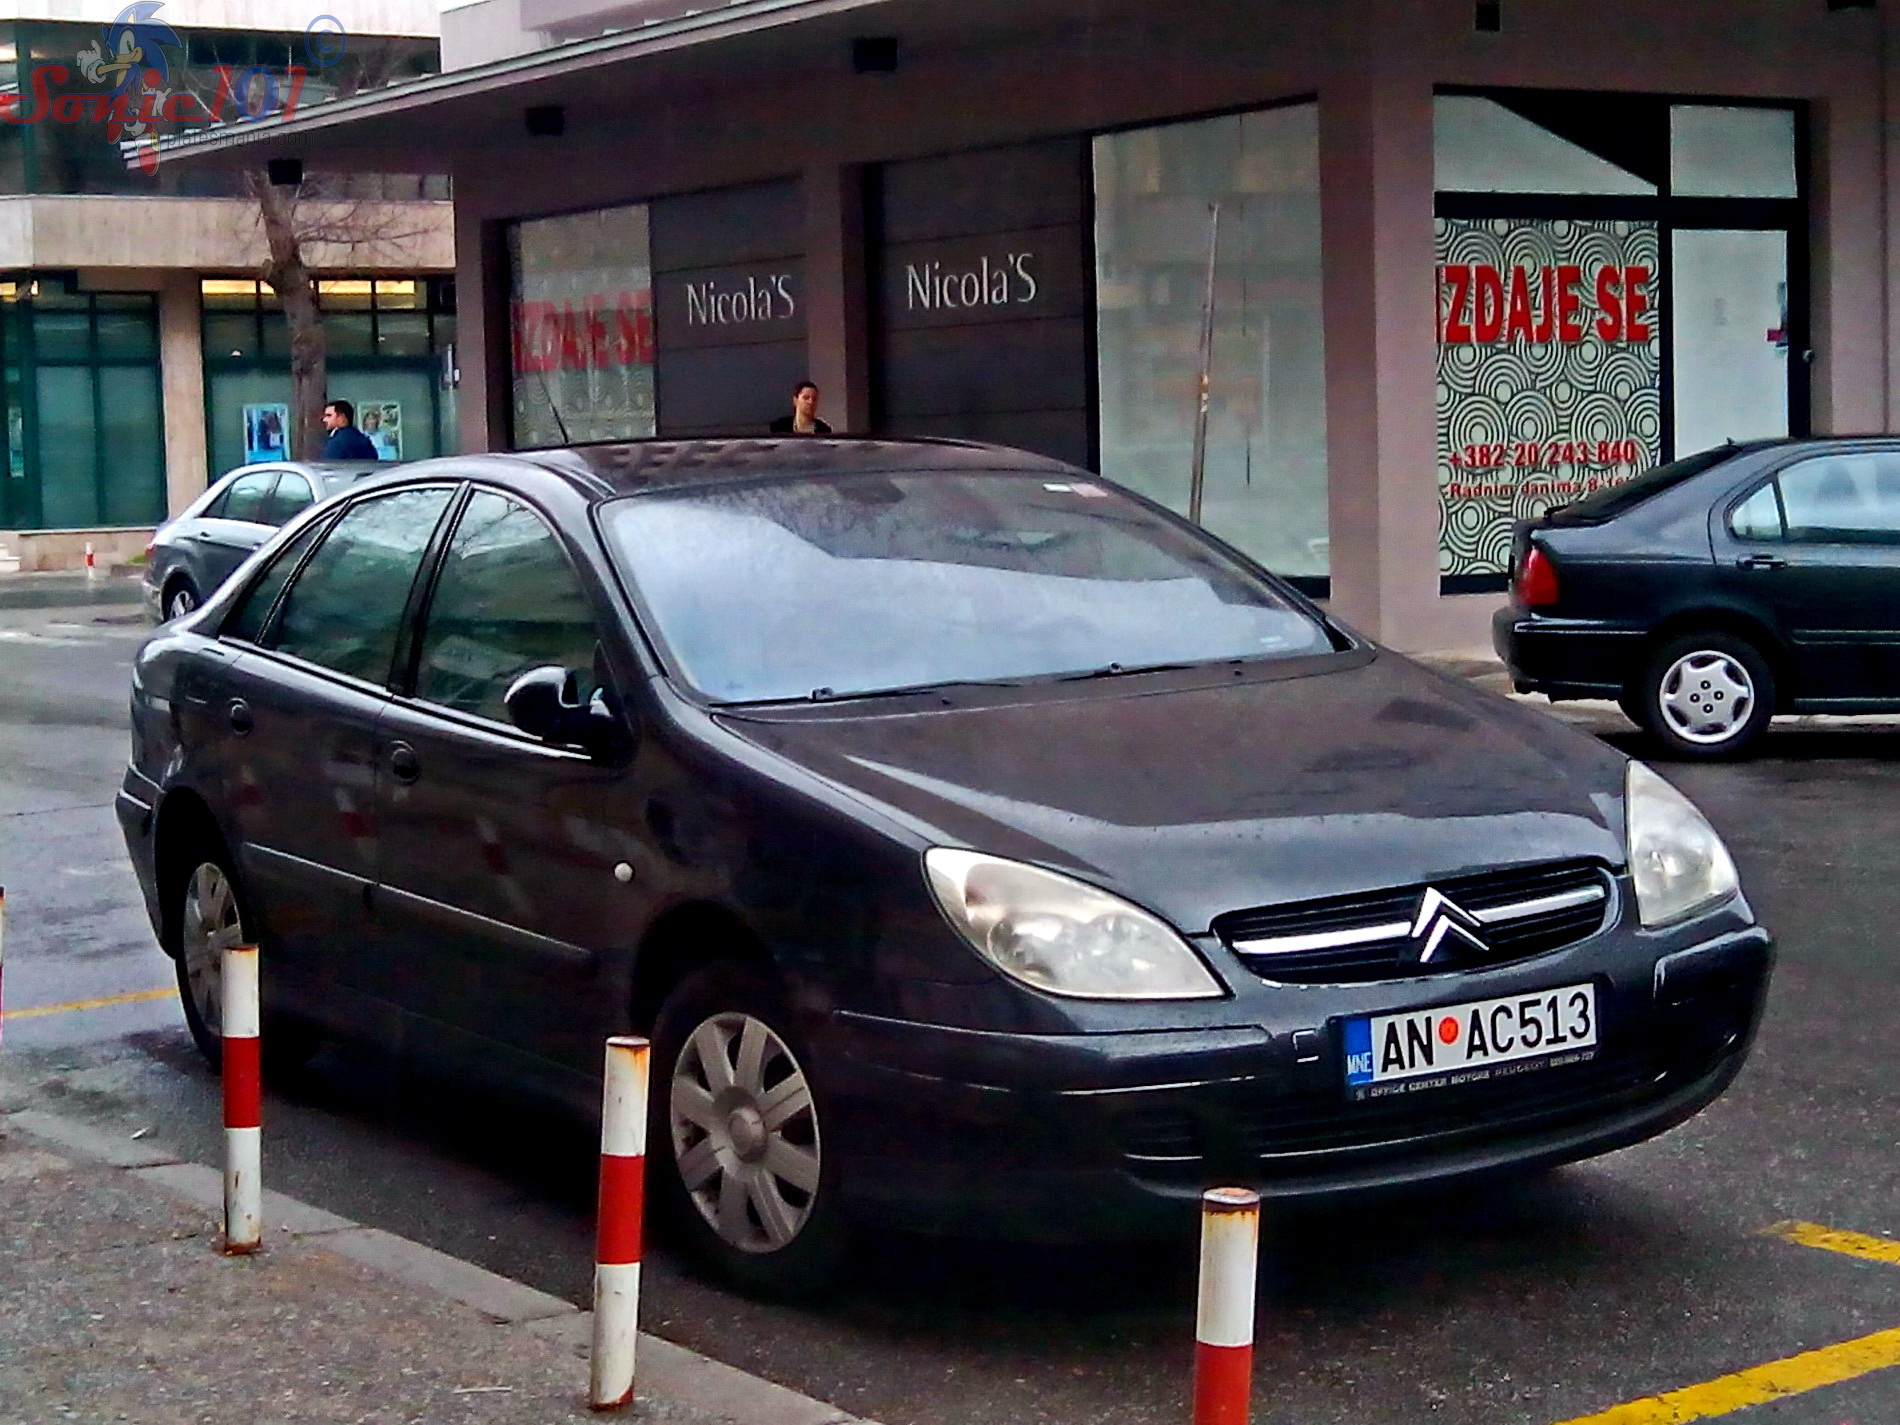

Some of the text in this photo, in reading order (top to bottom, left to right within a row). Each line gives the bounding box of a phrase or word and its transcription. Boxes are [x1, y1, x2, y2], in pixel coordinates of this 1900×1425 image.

[687, 274, 794, 325] Nicola'S
[906, 253, 1036, 310] Nicola'S
[1595, 265, 1650, 342] SE
[1449, 439, 1637, 469] +382 20 243 840
[1449, 482, 1512, 499] Radnim
[1522, 479, 1581, 496] danima
[1380, 991, 1591, 1074] AN AC513
[1346, 1051, 1373, 1076] MNE
